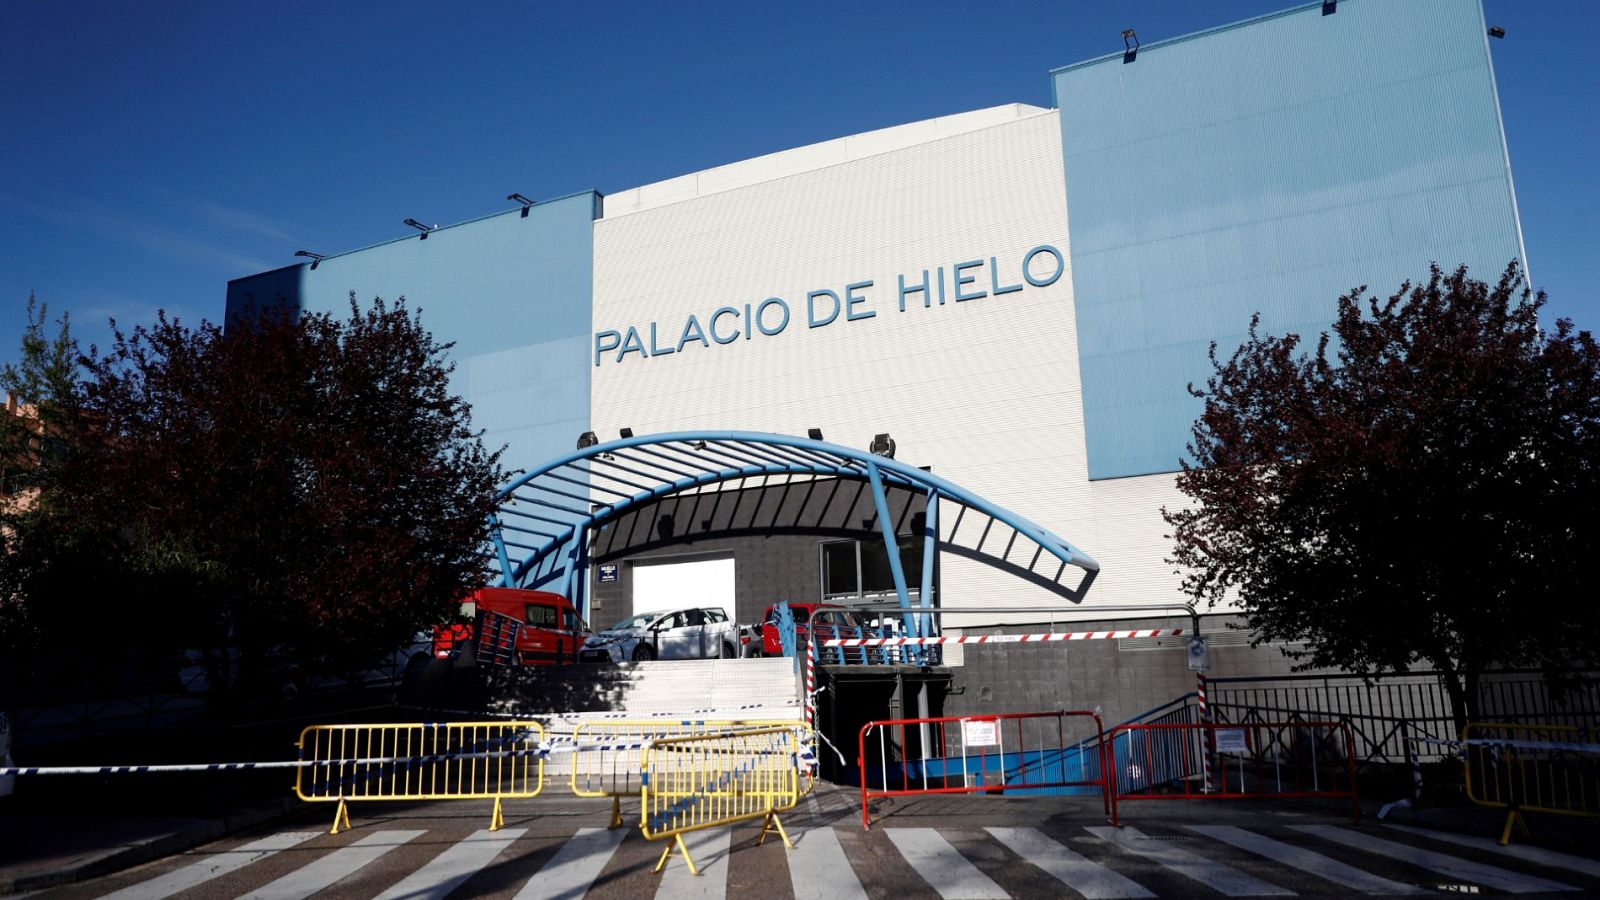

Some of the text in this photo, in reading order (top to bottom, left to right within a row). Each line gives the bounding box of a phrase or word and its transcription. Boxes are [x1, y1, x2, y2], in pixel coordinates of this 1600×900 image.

[595, 245, 1064, 367] PALACIO DE HIELO
